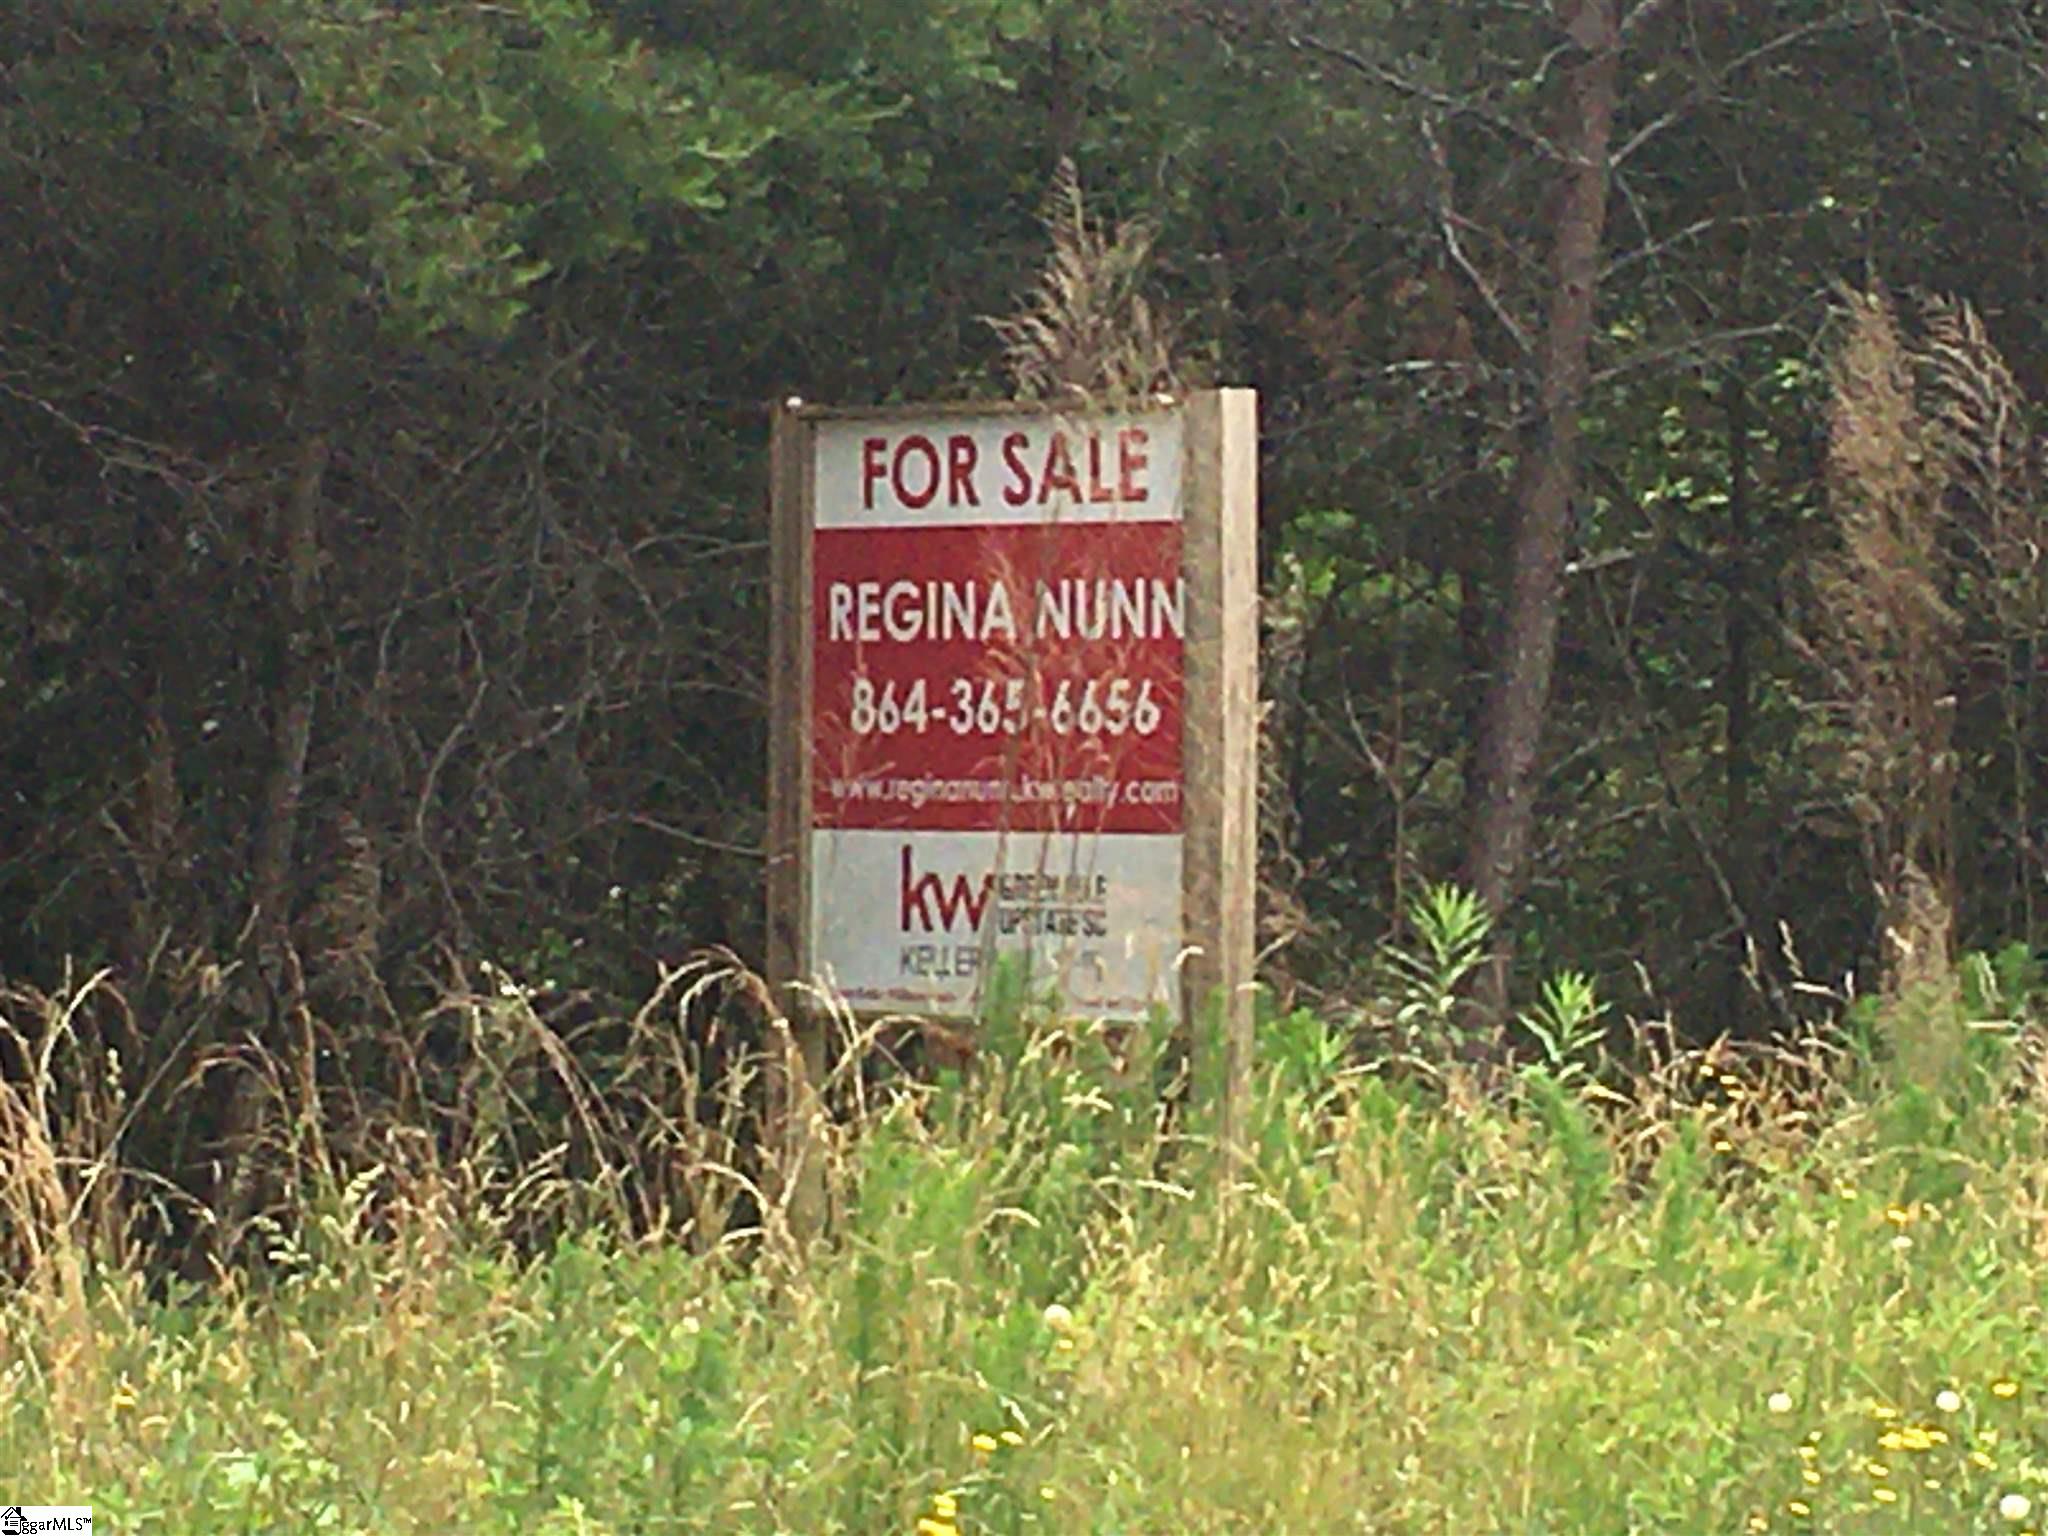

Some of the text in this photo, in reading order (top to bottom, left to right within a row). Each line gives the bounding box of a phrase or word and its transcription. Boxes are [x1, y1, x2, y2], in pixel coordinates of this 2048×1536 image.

[862, 429, 1150, 510] FOR SALE
[829, 577, 1187, 643] REGINA NUNN
[850, 678, 1161, 735] 864-365-6656
[901, 844, 995, 933] kw
